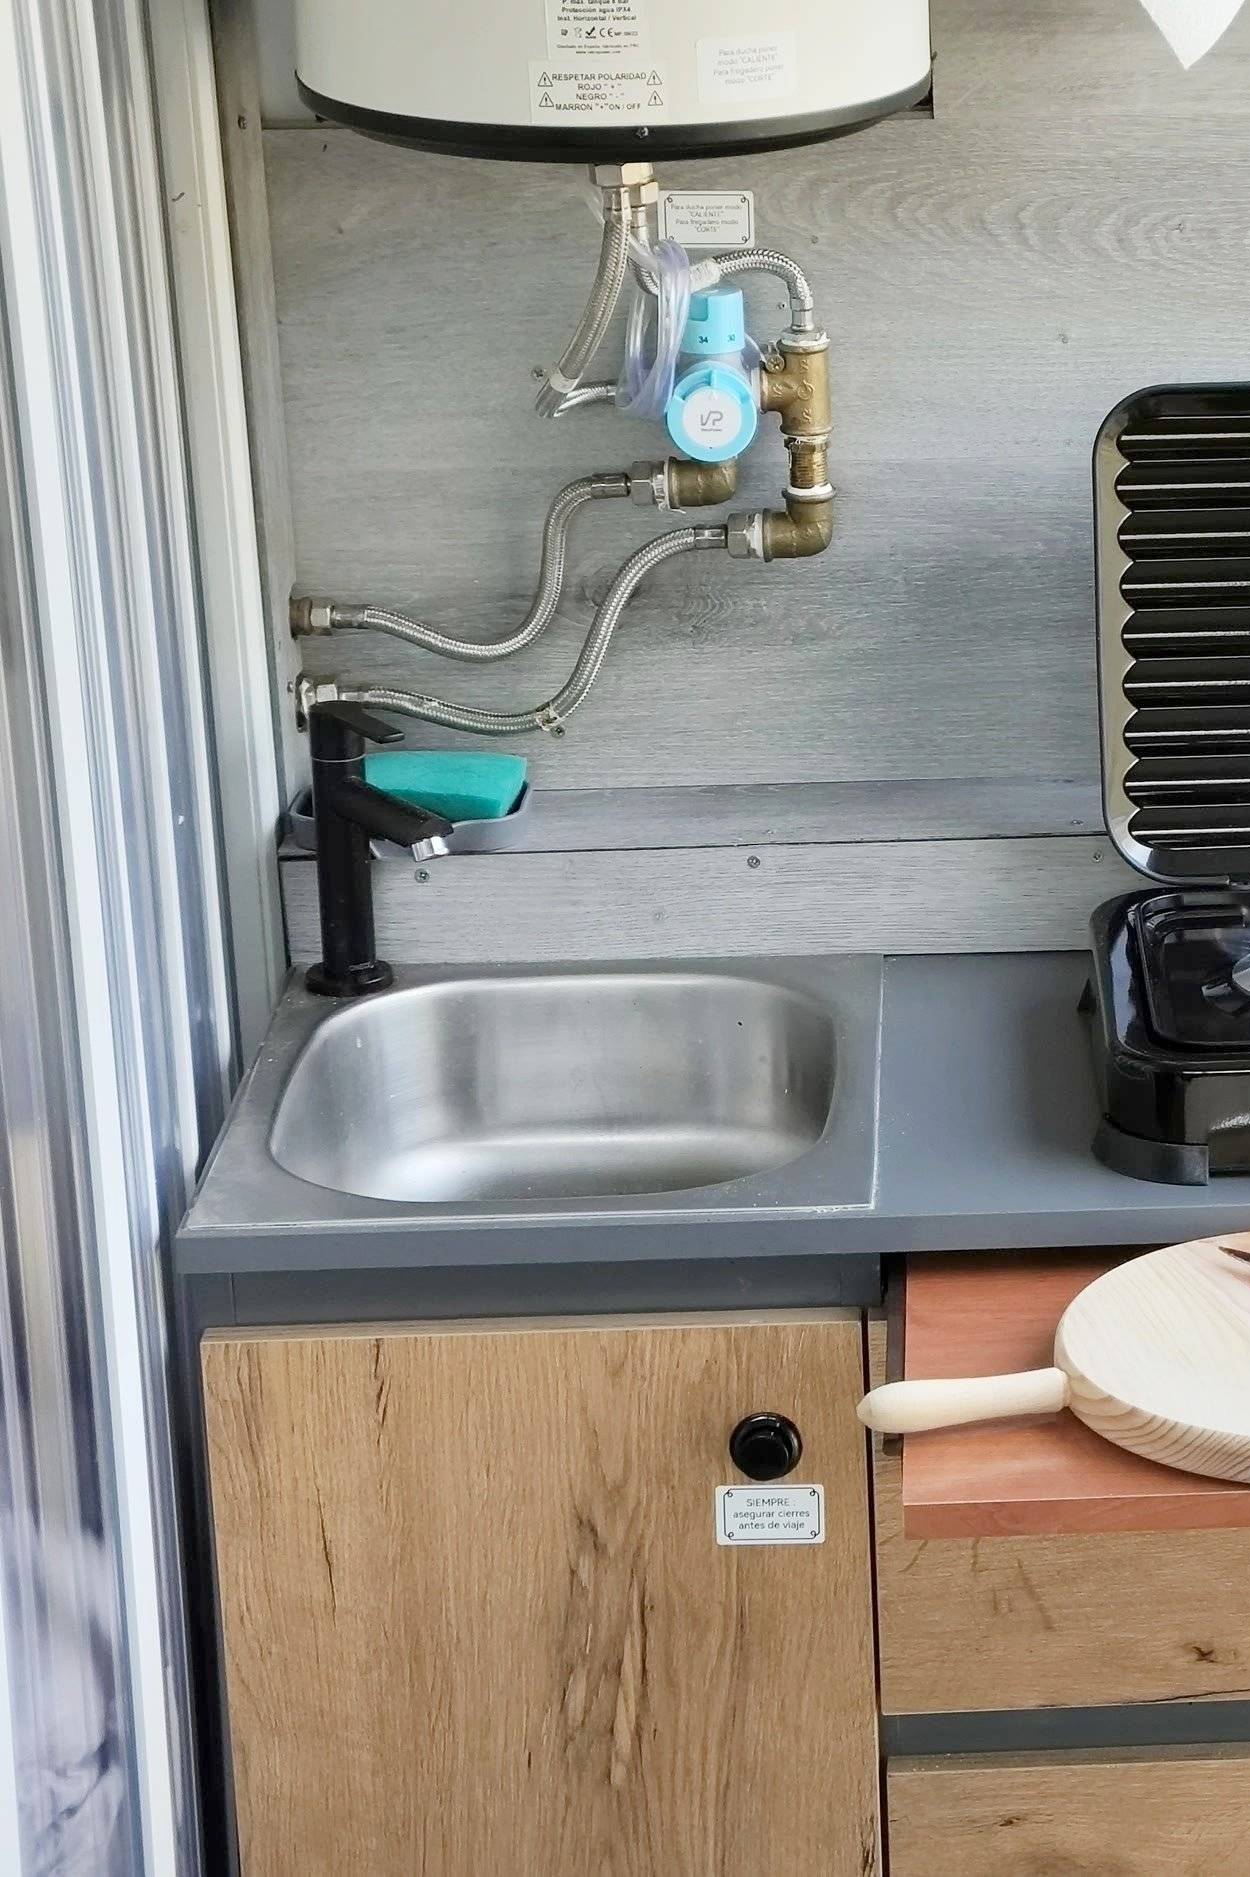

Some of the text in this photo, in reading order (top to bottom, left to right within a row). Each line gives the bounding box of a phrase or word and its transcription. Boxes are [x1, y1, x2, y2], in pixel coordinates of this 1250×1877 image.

[552, 72, 647, 81] RESPETAR POLARIDAD
[577, 82, 602, 91] ROJO
[576, 92, 607, 101] NEGRO
[555, 103, 593, 111] MARRON
[698, 335, 709, 344] 34
[746, 1498, 790, 1507] SIEMPRE
[732, 1509, 810, 1520] asegurar cierres
[738, 1520, 805, 1531] antes de viaje
